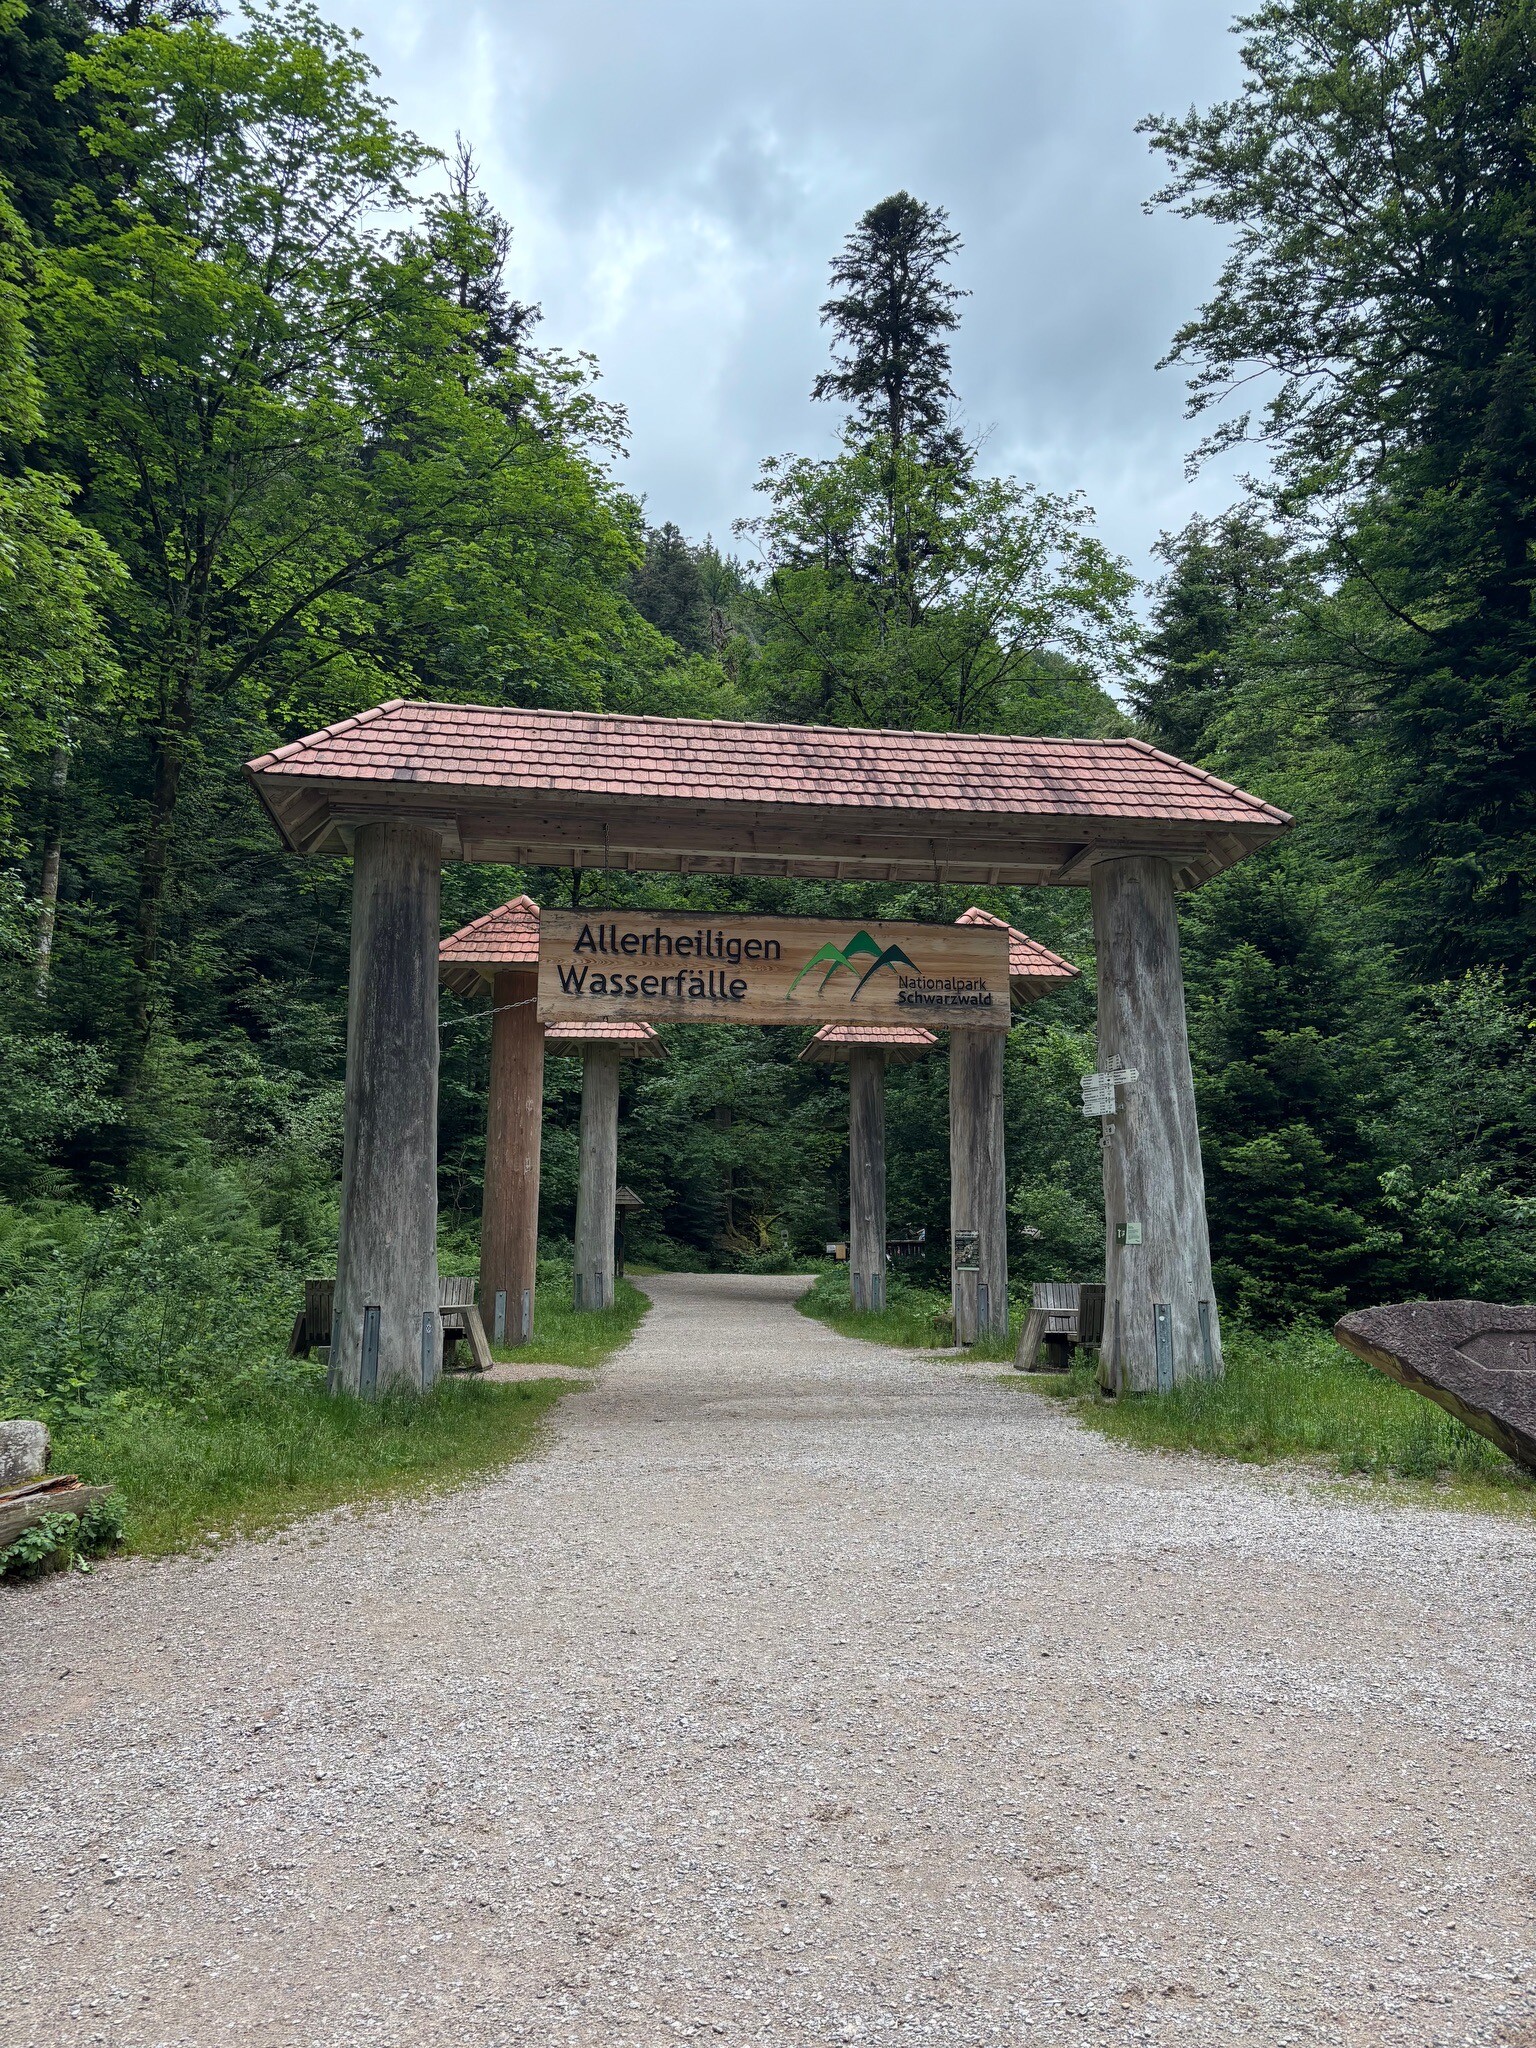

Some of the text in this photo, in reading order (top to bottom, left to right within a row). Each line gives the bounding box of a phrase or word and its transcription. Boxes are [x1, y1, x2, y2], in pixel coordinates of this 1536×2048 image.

[573, 923, 781, 965] Allerheiligen
[557, 964, 748, 999] Wasserfälle
[898, 975, 987, 994] Nationalpark
[898, 990, 992, 1006] Schwarzwald
